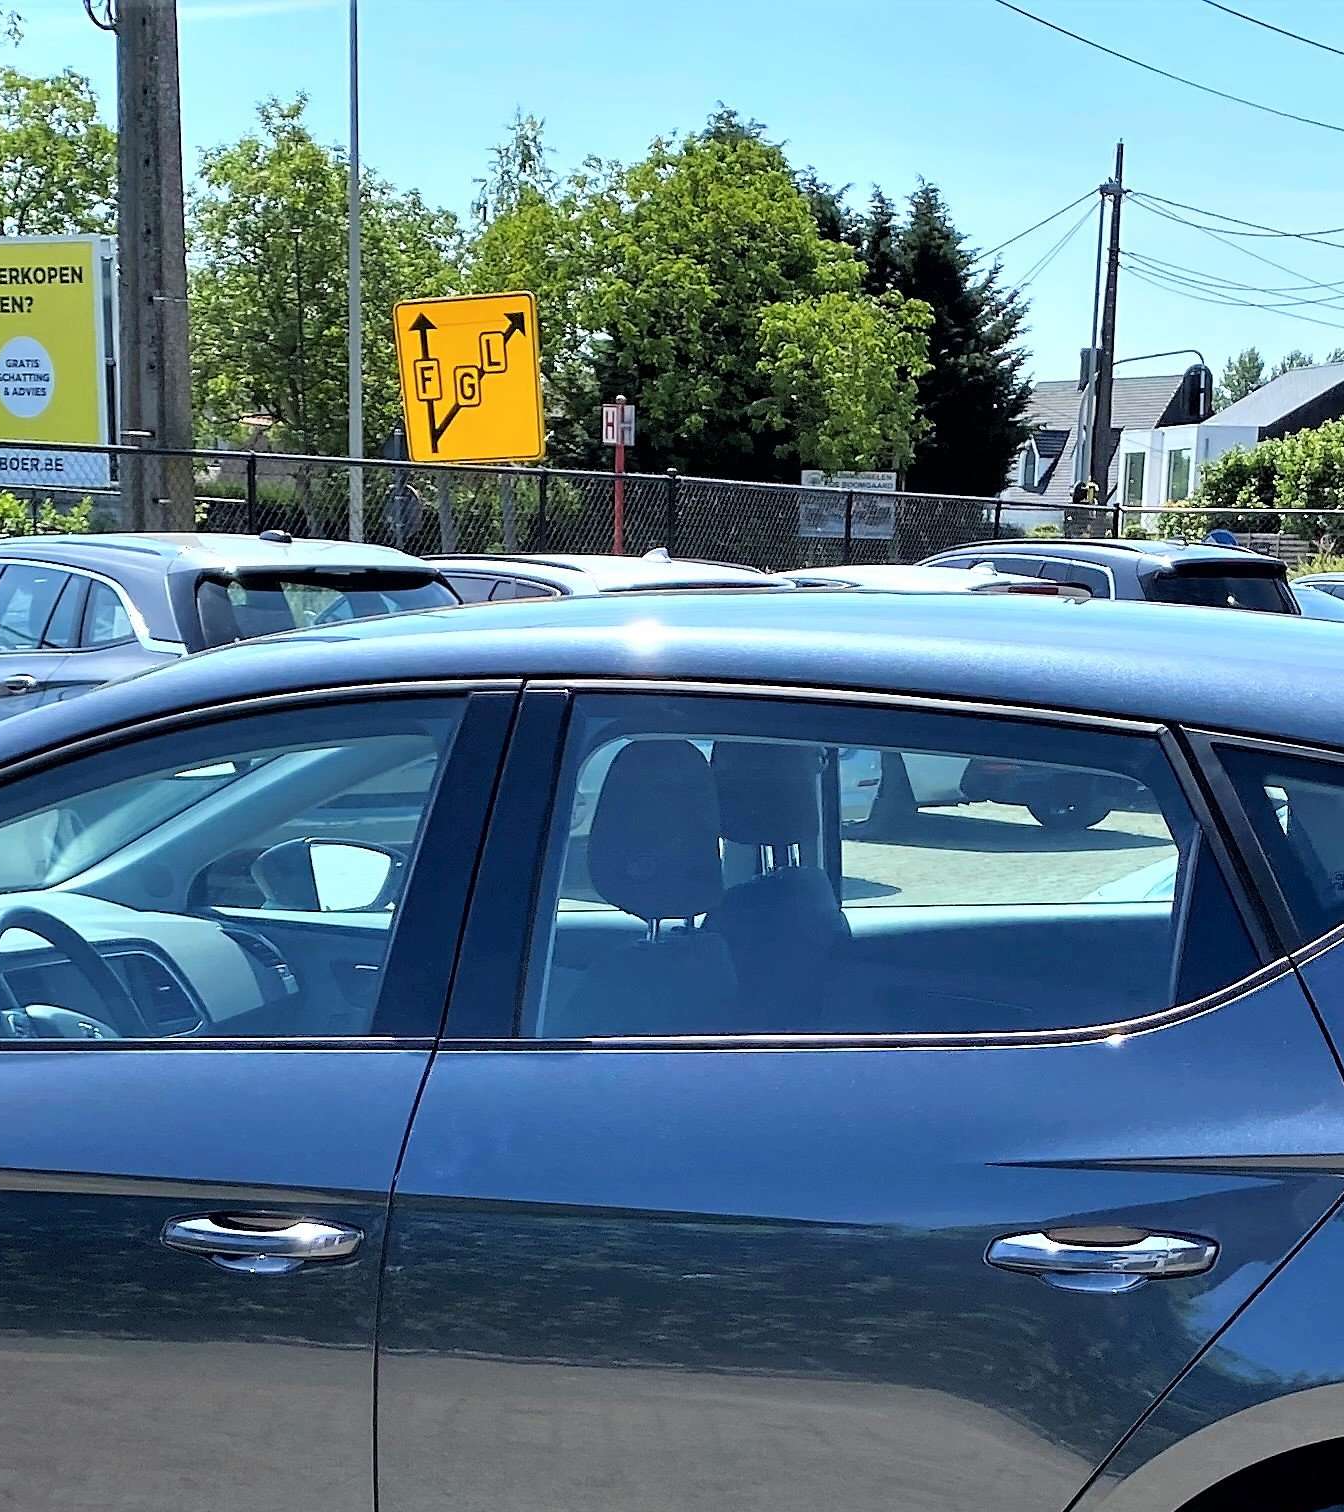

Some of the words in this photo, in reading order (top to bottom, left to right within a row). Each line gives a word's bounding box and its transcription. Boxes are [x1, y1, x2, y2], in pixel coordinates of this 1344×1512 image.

[5, 359, 40, 368] GRATIS
[486, 339, 501, 366] L
[11, 387, 47, 396] ADVIES
[420, 366, 434, 394] F
[459, 372, 476, 400] G
